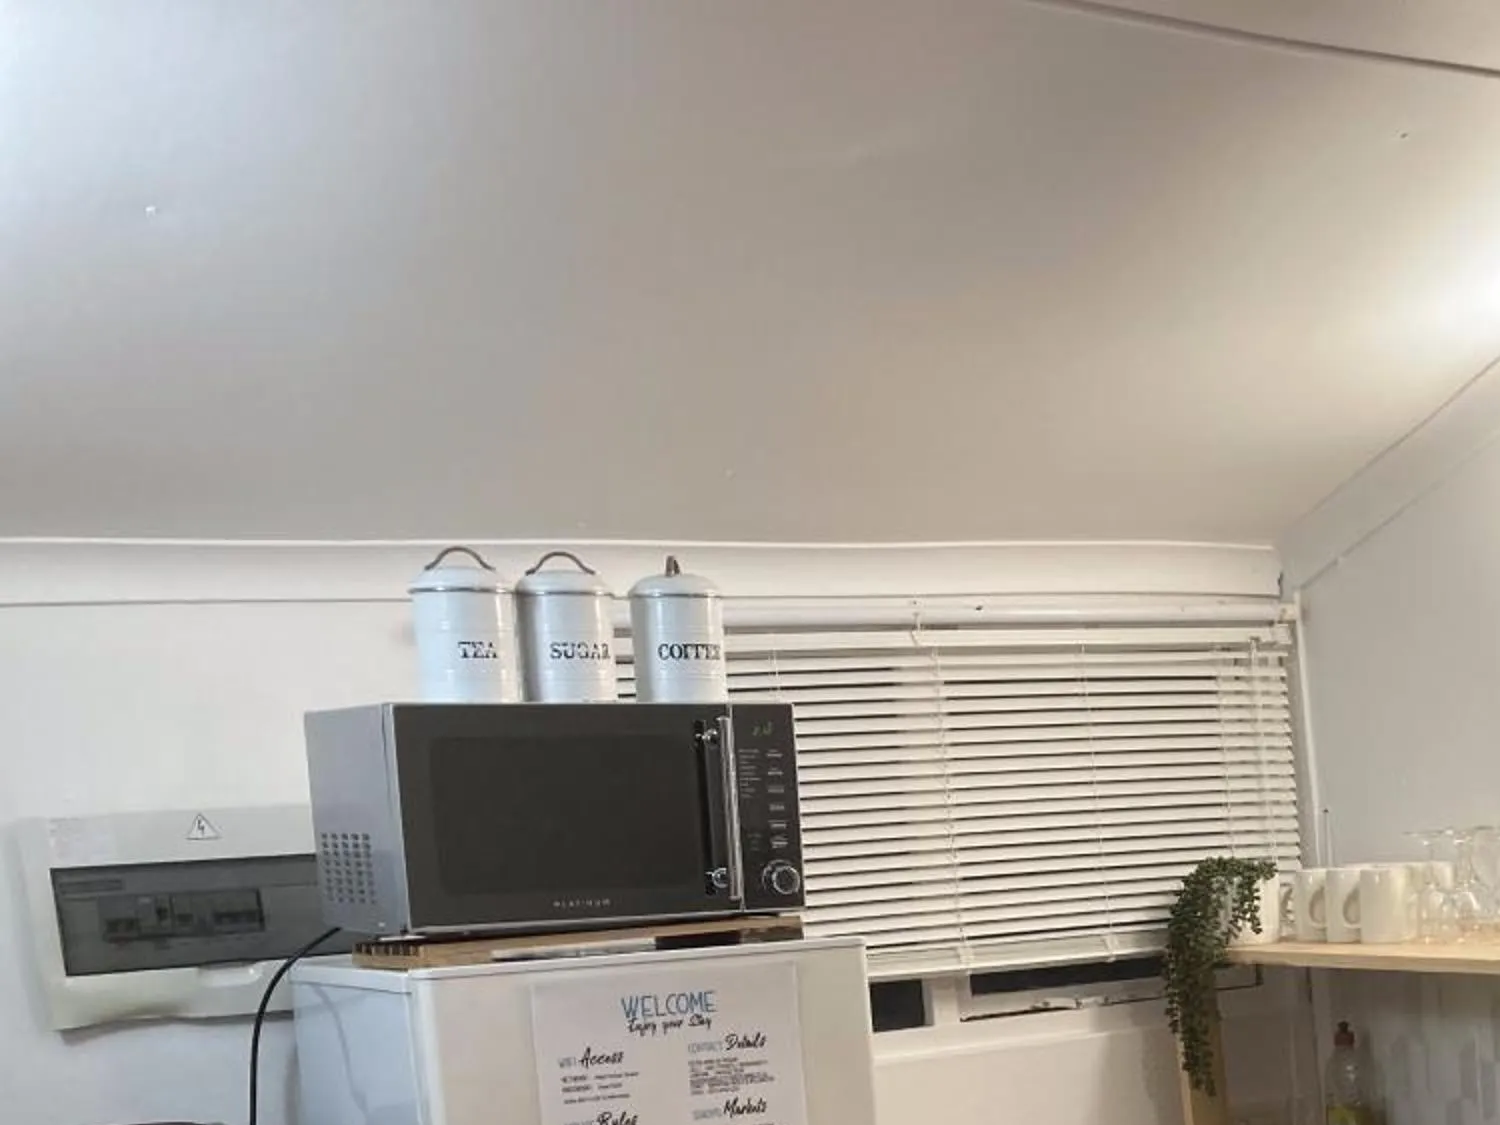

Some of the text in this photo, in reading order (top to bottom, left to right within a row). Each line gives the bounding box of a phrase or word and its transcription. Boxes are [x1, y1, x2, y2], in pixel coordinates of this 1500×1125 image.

[457, 641, 498, 659] TEA
[620, 990, 718, 1019] WELCOME
[578, 1046, 625, 1070] Access
